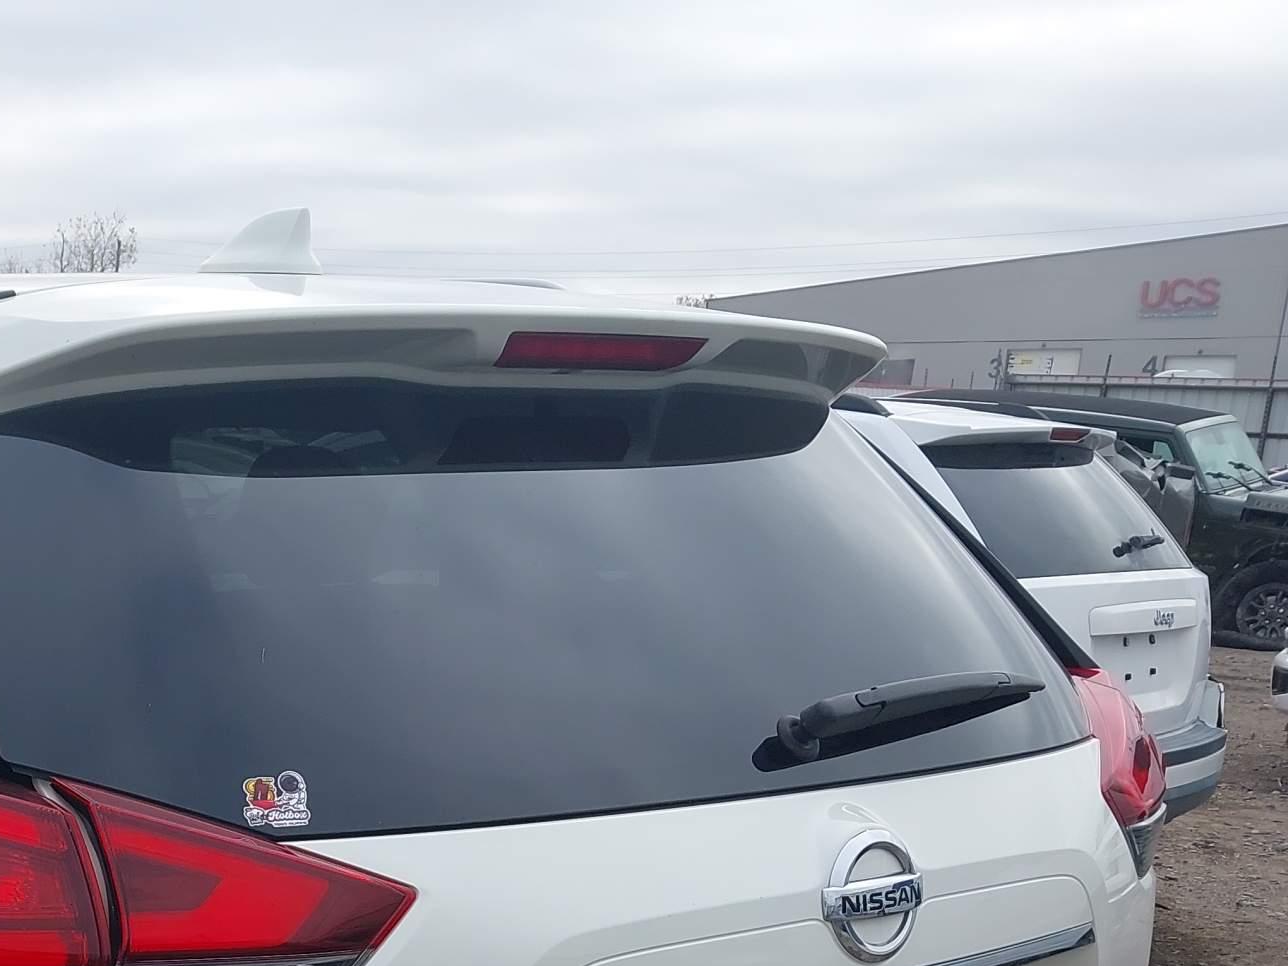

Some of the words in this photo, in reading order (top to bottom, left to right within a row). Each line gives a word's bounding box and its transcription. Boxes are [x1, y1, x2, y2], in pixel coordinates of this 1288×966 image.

[1140, 278, 1221, 309] UCS
[1142, 356, 1158, 376] 4
[841, 882, 921, 914] NISSAN
